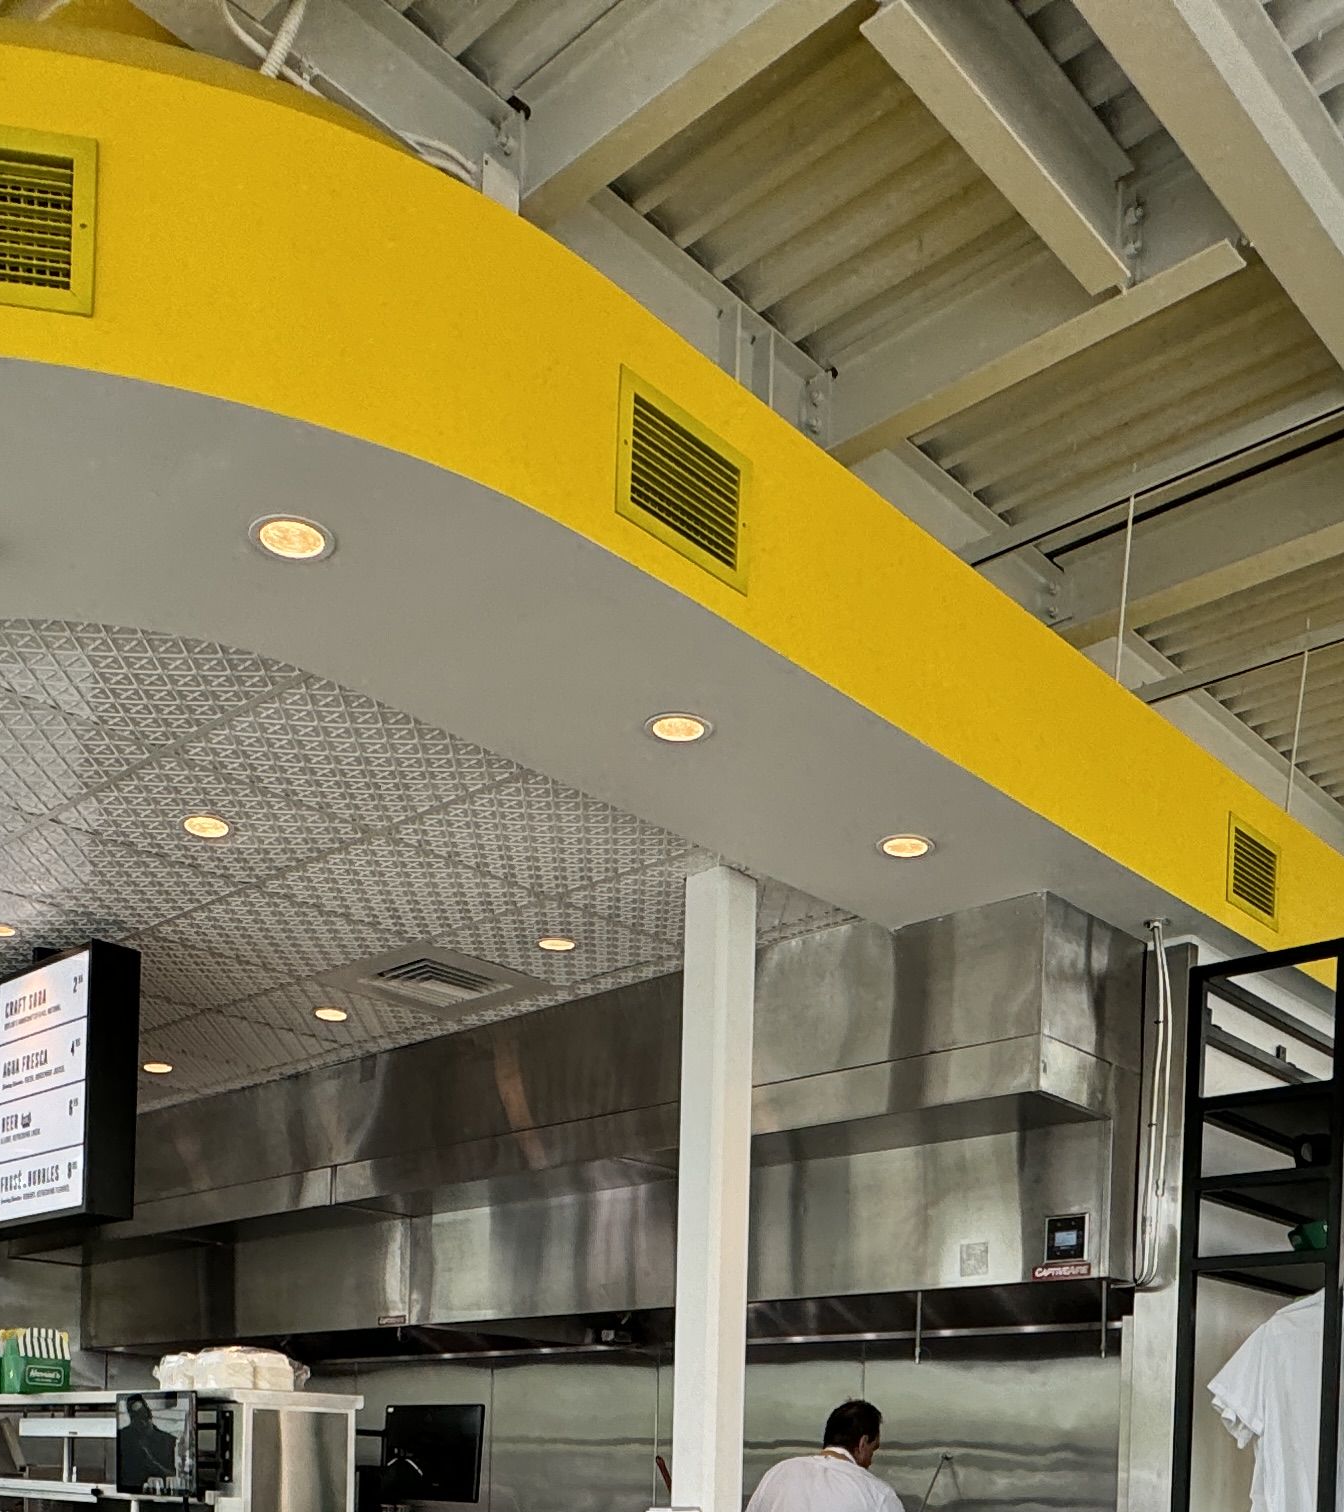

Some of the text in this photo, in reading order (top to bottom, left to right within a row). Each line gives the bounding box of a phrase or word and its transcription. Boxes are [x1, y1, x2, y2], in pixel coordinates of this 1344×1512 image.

[5, 996, 26, 1018] CRAFT
[22, 1049, 48, 1072] FRESCA
[2, 1114, 19, 1133] BEER
